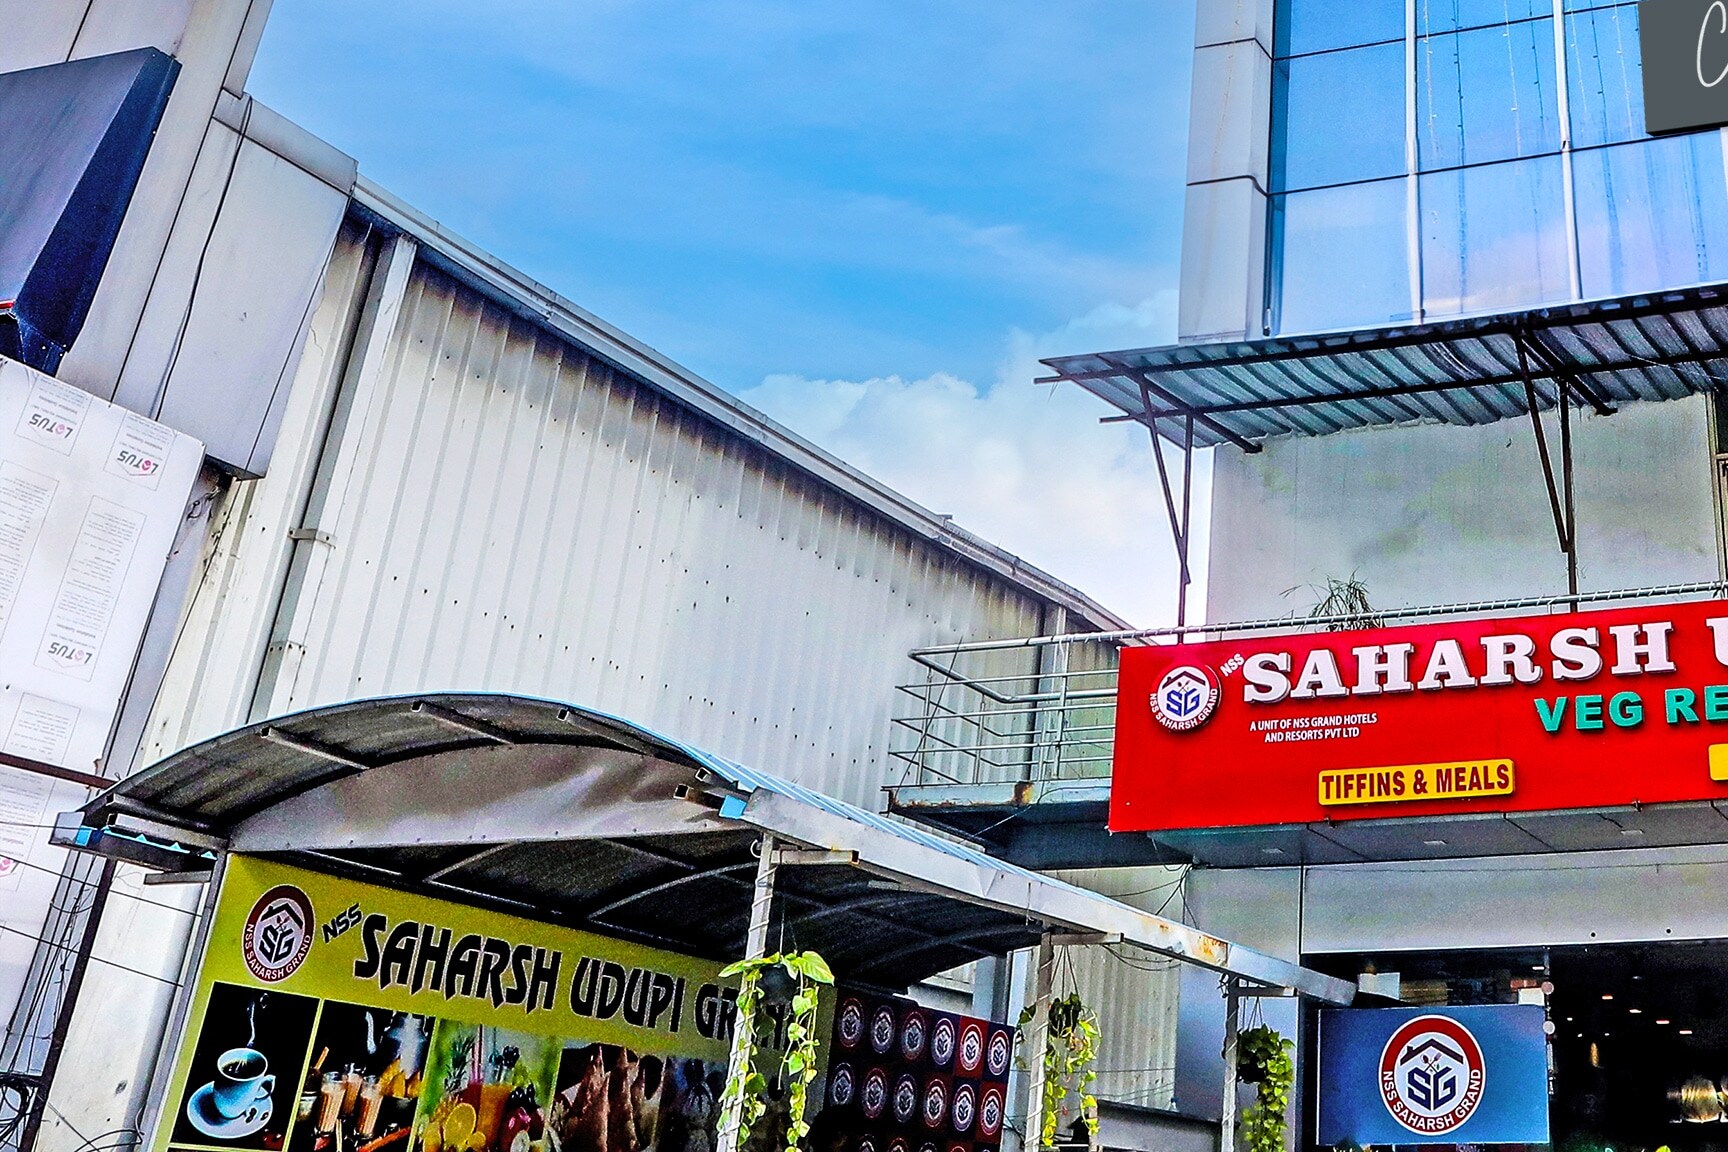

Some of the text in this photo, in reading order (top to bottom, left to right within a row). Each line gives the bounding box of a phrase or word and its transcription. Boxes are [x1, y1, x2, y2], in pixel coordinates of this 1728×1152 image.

[29, 413, 74, 439] LOTUS
[117, 450, 159, 474] LOTUS
[48, 642, 93, 665] LOTUS
[1220, 653, 1245, 677] NSS
[1243, 621, 1677, 703] SAHARSH
[1150, 688, 1218, 730] NSS SAHARSH GRAND
[1250, 713, 1378, 731] A UNIT OF NSS GRAND HOTELS
[1535, 691, 1644, 732] VEG
[1264, 727, 1360, 743] AND RESORTS PVT LTD
[1321, 764, 1510, 800] TIFFINS & MEALS
[321, 902, 363, 945] NSS
[244, 923, 312, 980] NSS SAHARSH GRAND
[353, 912, 563, 1015] SAHARSH
[569, 956, 687, 1033] UDUPI
[1383, 1068, 1481, 1131] NSS SAHARSH GRAND
[1407, 1066, 1457, 1111] SG
